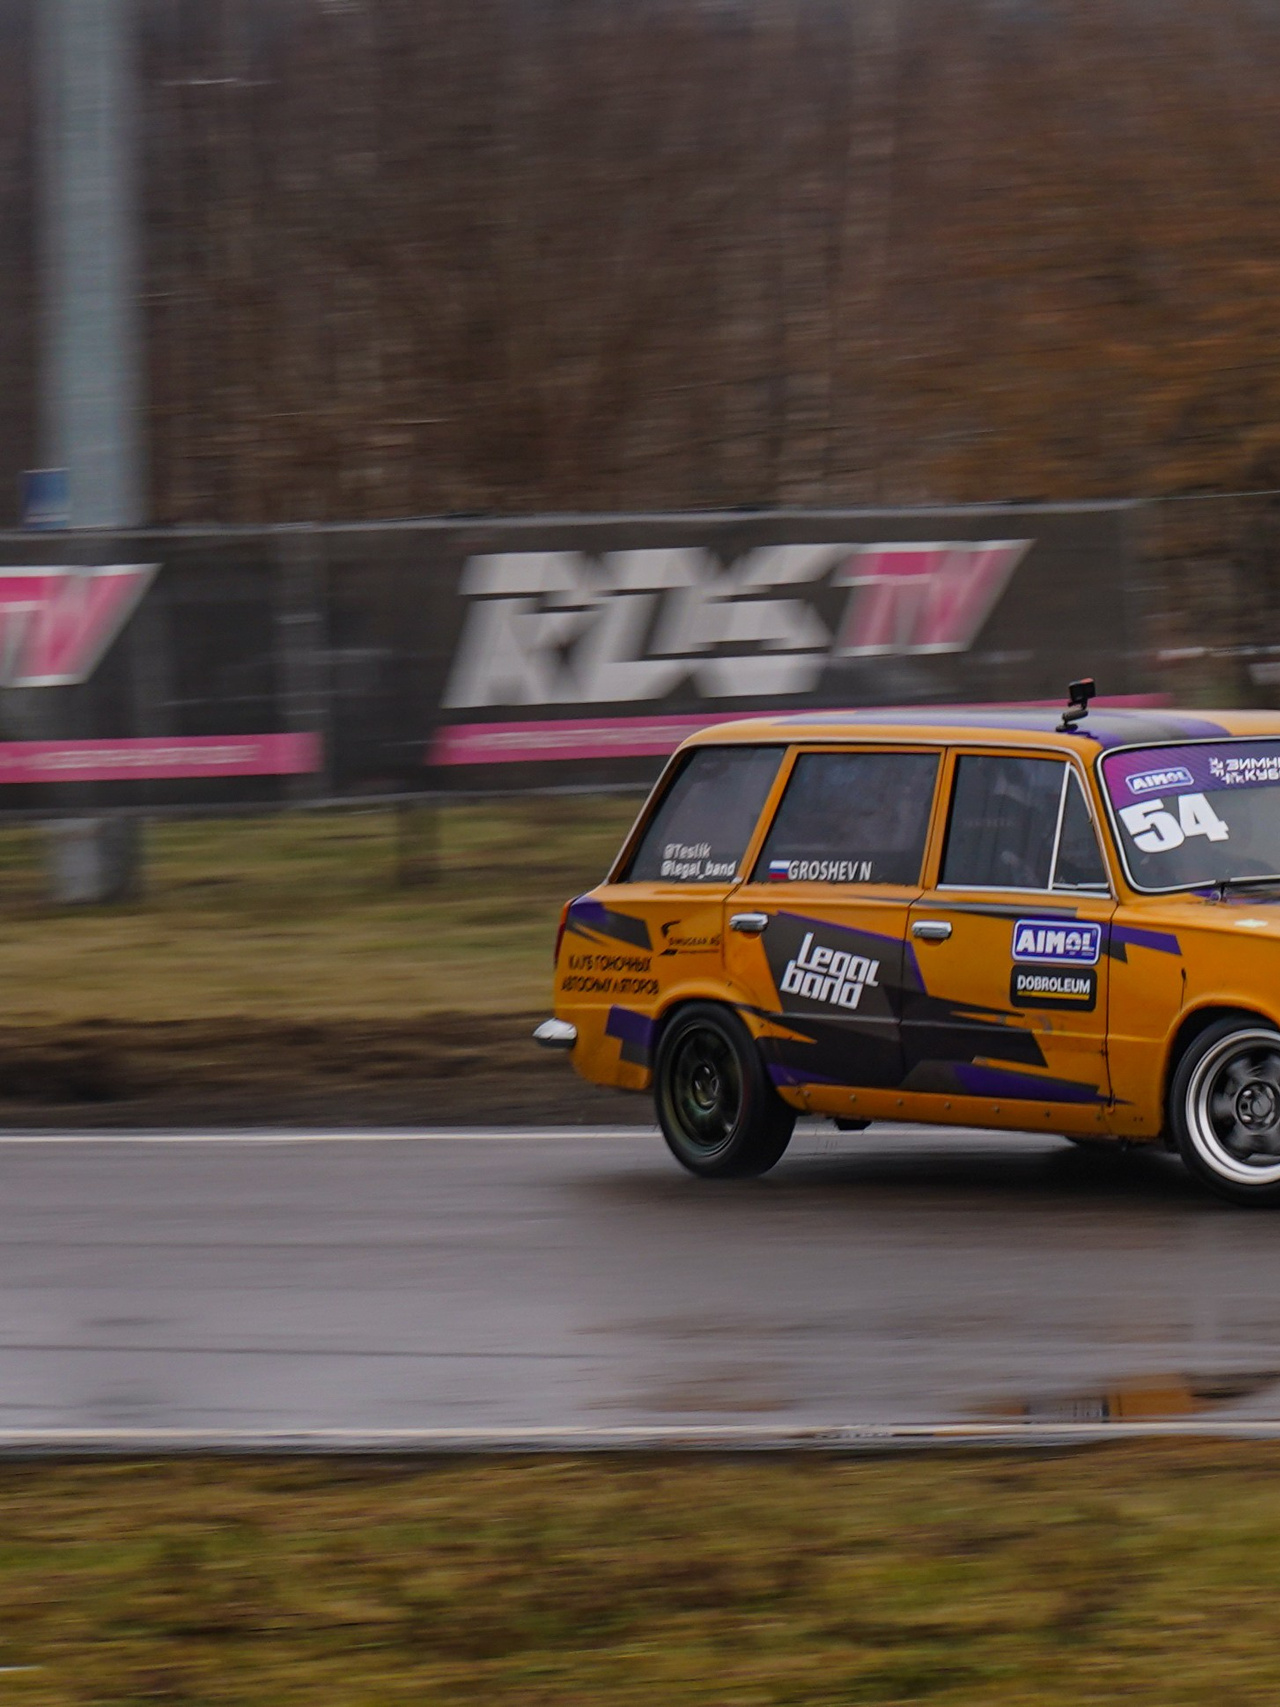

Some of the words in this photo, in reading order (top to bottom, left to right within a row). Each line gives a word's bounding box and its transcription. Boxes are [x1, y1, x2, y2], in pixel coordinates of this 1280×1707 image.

[1119, 793, 1229, 853] 54
[787, 860, 859, 881] GROSHEV
[859, 861, 873, 881] N
[1016, 929, 1096, 954] AIMOL
[1016, 975, 1091, 994] DOBROLEUM
